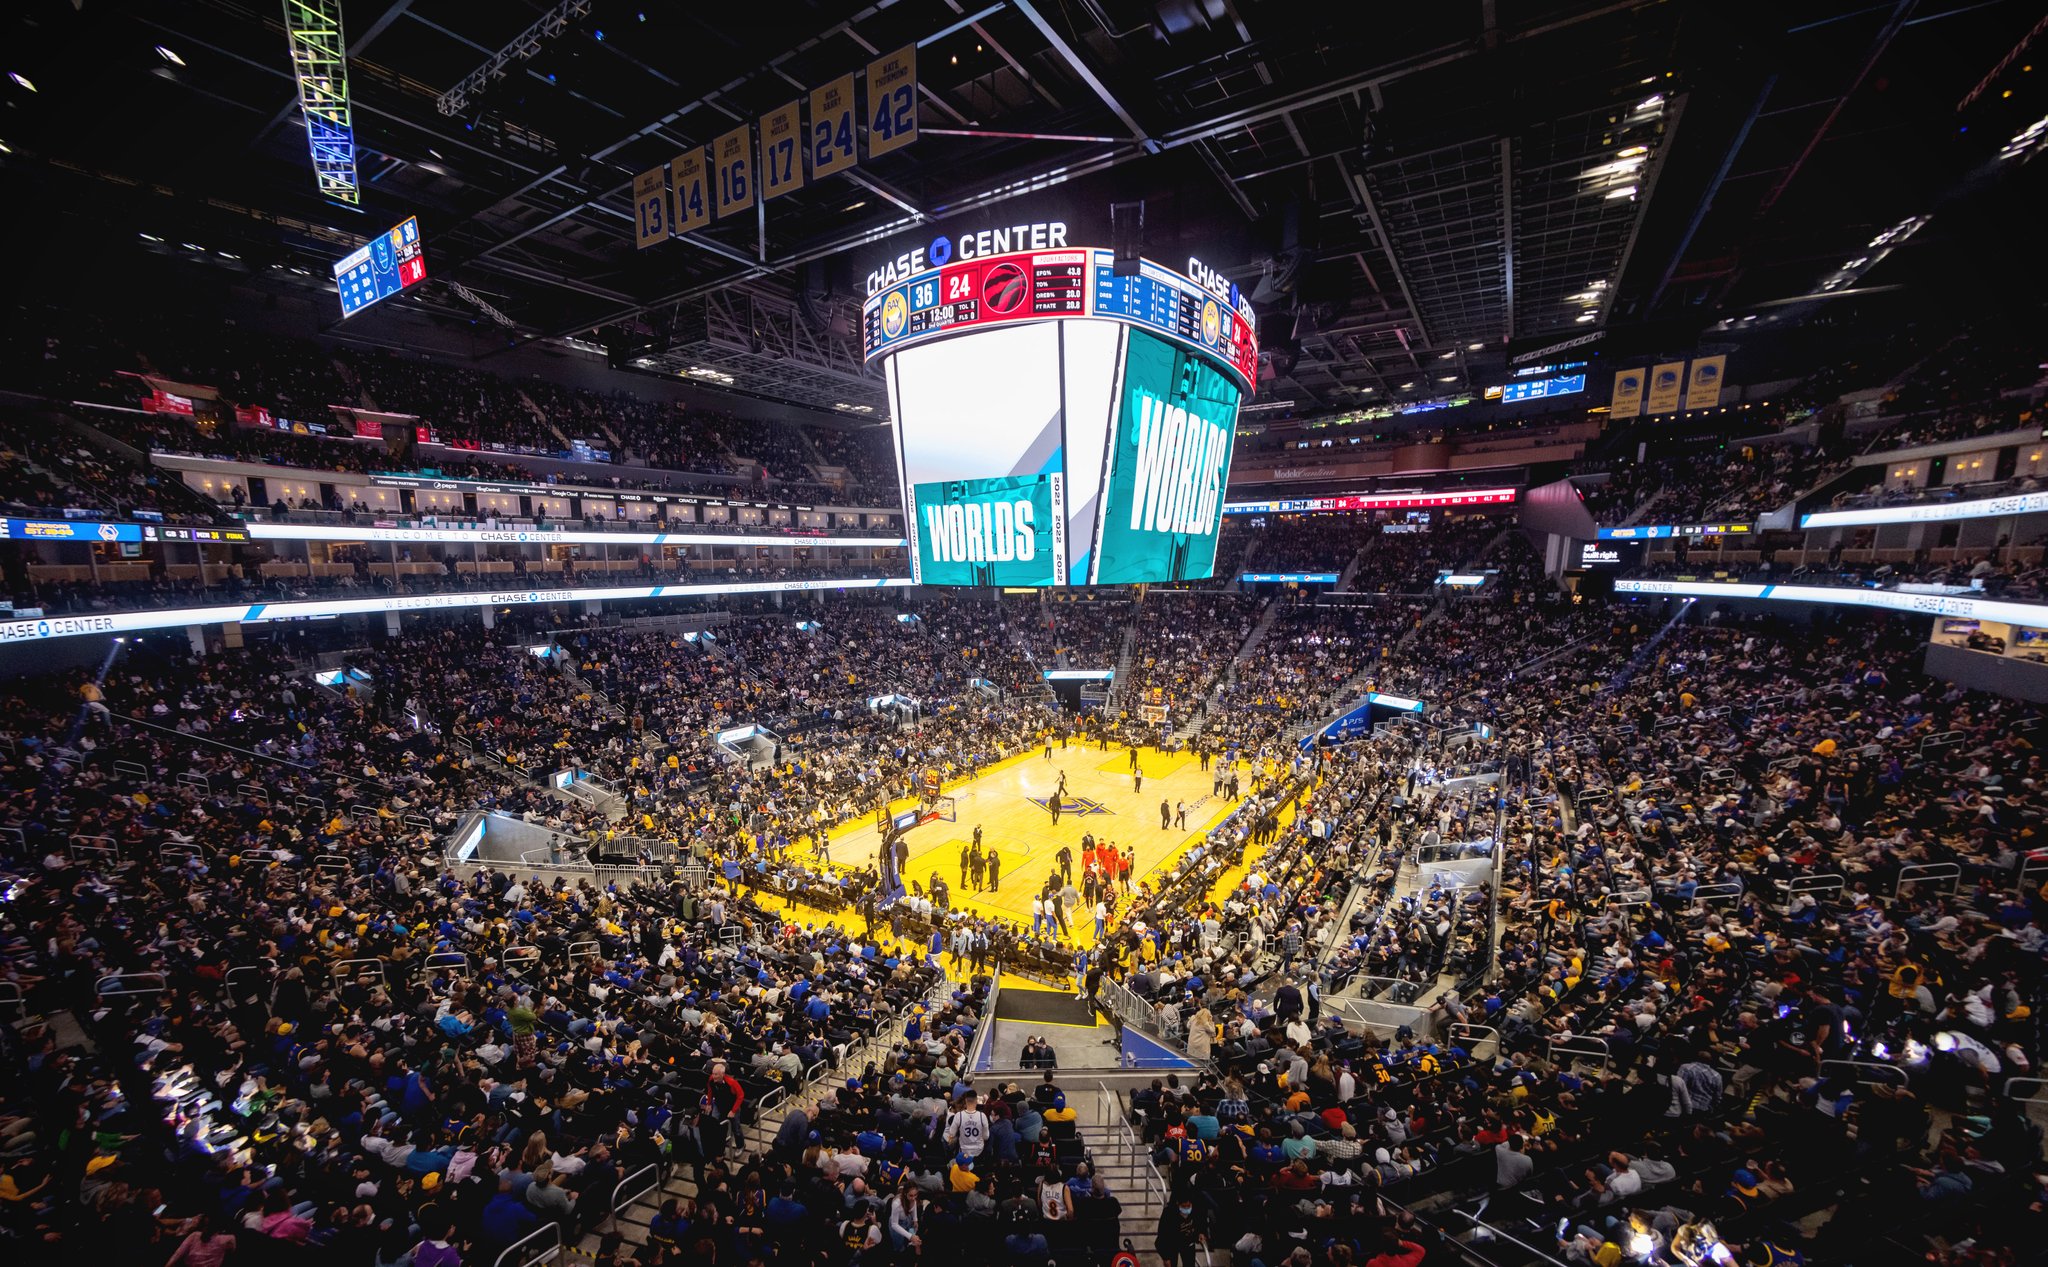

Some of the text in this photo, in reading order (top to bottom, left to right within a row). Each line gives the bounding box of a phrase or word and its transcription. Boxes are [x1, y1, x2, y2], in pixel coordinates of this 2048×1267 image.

[873, 84, 913, 141] 42
[816, 110, 852, 167] 24
[768, 137, 793, 187] 17
[722, 160, 746, 206] 16
[679, 179, 703, 223] 14
[640, 197, 662, 238] 13
[404, 222, 415, 242] 36
[867, 222, 1067, 297] CHASE CENTER
[411, 260, 422, 279] 24
[950, 274, 971, 299] 24
[1189, 256, 1230, 302] CHASE
[888, 297, 900, 312] BAY
[916, 283, 932, 308] 36
[930, 305, 954, 322] 12:00
[1234, 323, 1240, 344] 24
[1130, 395, 1227, 535] WORLDS
[1989, 499, 2018, 513] CHASE
[179, 530, 188, 538] 31
[372, 531, 562, 541] WELCOME TO CHASE CENTER
[927, 500, 1035, 562] WORLDS
[1583, 551, 1618, 559] built right
[1584, 544, 1595, 552] 5G
[1642, 583, 1673, 591] CENTER
[384, 592, 573, 608] WELCOME TO CHASE CENTER
[1914, 597, 1938, 611] CHASE
[1946, 600, 1974, 615] CENTER
[54, 617, 114, 633] CENTER
[1376, 1069, 1390, 1083] 30
[965, 1127, 979, 1138] 30
[1187, 1149, 1202, 1161] 30
[1046, 1190, 1060, 1199] ELLIS
[1049, 1201, 1057, 1218] 8
